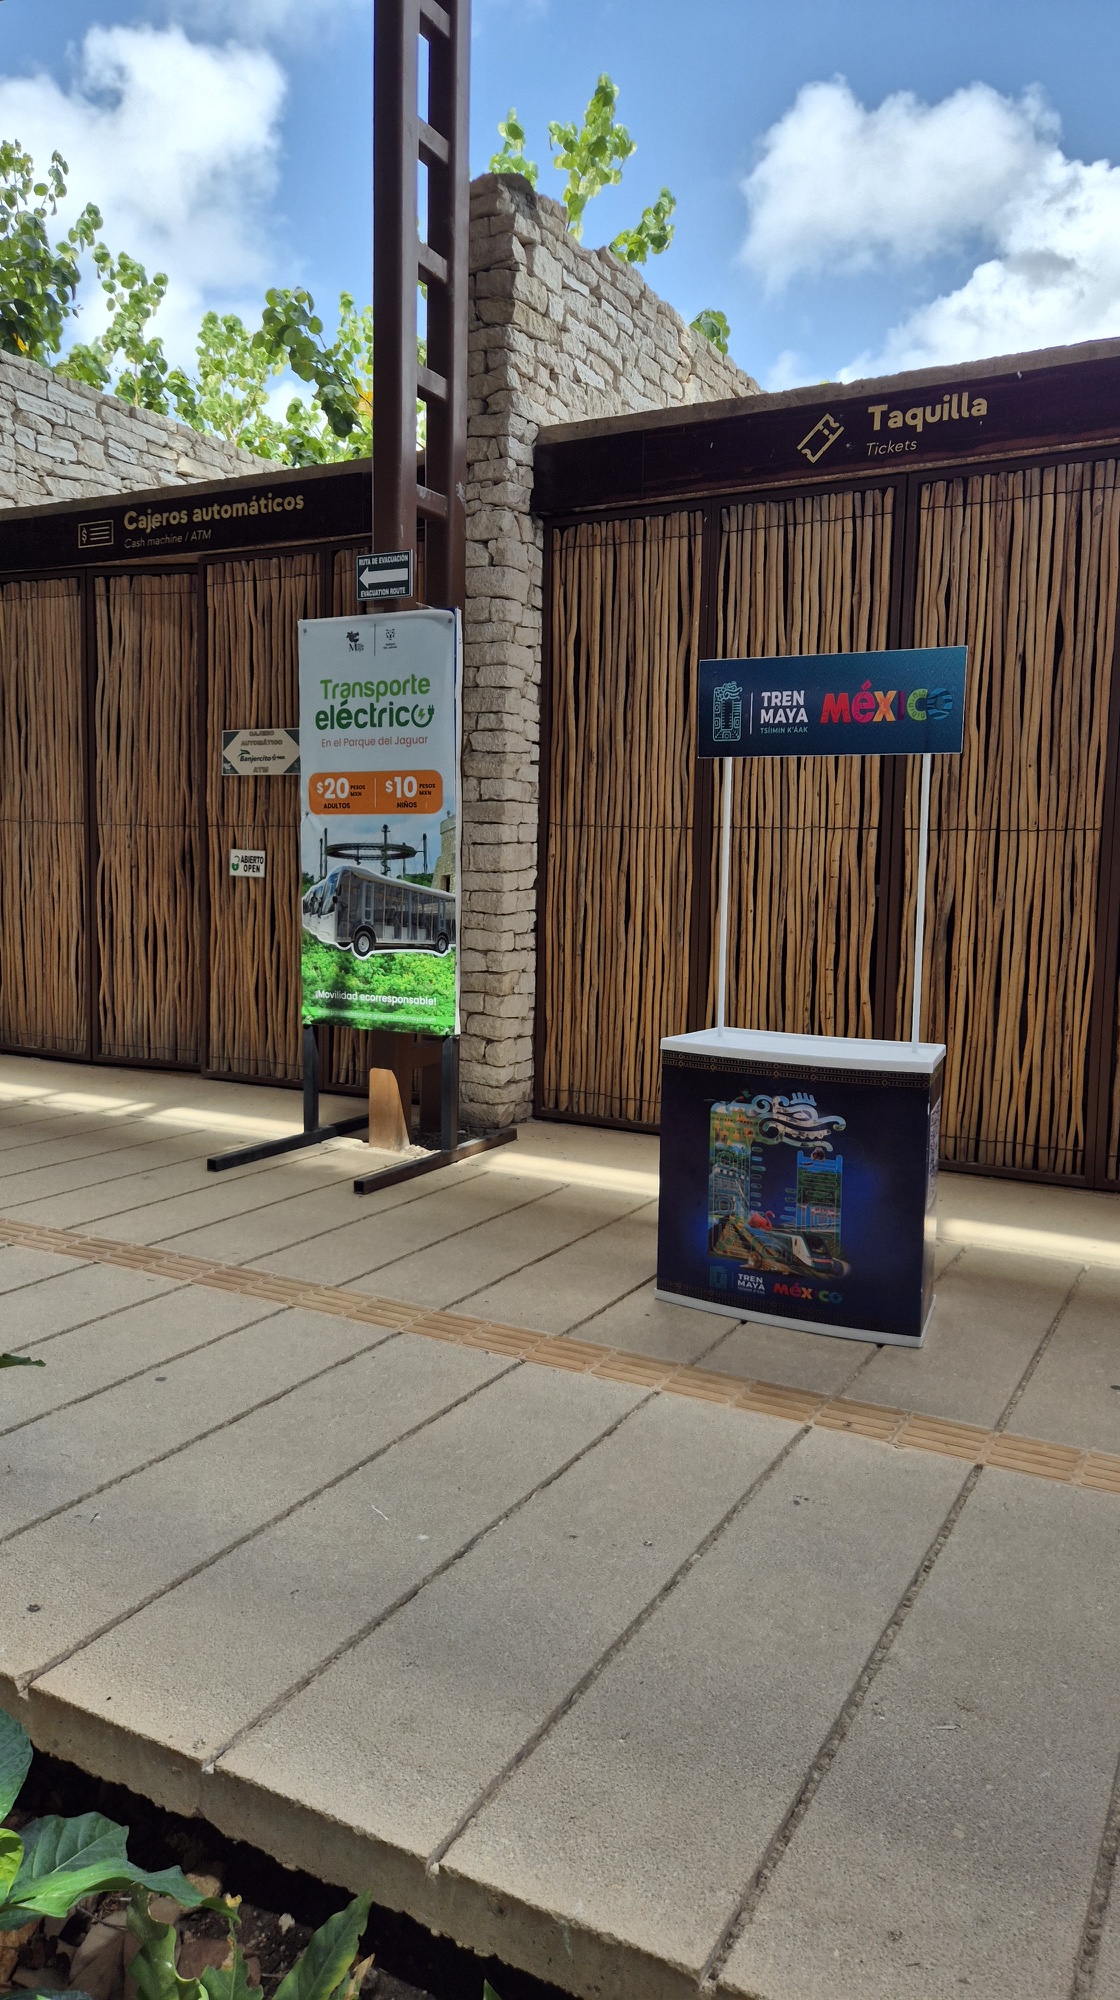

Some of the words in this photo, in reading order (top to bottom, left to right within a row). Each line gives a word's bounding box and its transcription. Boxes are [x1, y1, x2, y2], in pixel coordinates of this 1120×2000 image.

[868, 392, 988, 433] Taquilla
[866, 440, 917, 456] Tickets
[124, 509, 188, 533] Cajeros
[193, 493, 304, 523] automáticos
[124, 533, 145, 549] Cash
[147, 533, 183, 547] machine
[190, 529, 212, 541] ATM
[359, 558, 371, 566] RUTA
[372, 557, 378, 565] DE
[379, 554, 408, 564] EVACUACIÓN
[361, 588, 389, 597] EVACUATION
[390, 587, 406, 595] ROUTE
[320, 673, 431, 703] Transporte
[761, 690, 805, 707] TREN
[315, 699, 435, 730] eléctrico
[760, 708, 809, 724] MAYA
[322, 738, 332, 748] En
[334, 737, 342, 747] el
[344, 737, 376, 749] Parque
[378, 736, 393, 746] del
[394, 736, 428, 748] Jaguar
[239, 754, 272, 763] Banjercito
[317, 777, 350, 800] $20
[385, 775, 418, 798] $10
[323, 802, 351, 810] ADULTOS
[396, 800, 418, 809] NIÑOS
[240, 855, 265, 865] ABIERTO
[243, 864, 261, 873] OPEN
[315, 990, 358, 1001] ¡Movilidad
[360, 992, 437, 1006] ecorresponsable!
[737, 1280, 766, 1291] MAYA
[738, 1273, 763, 1284] TREN
